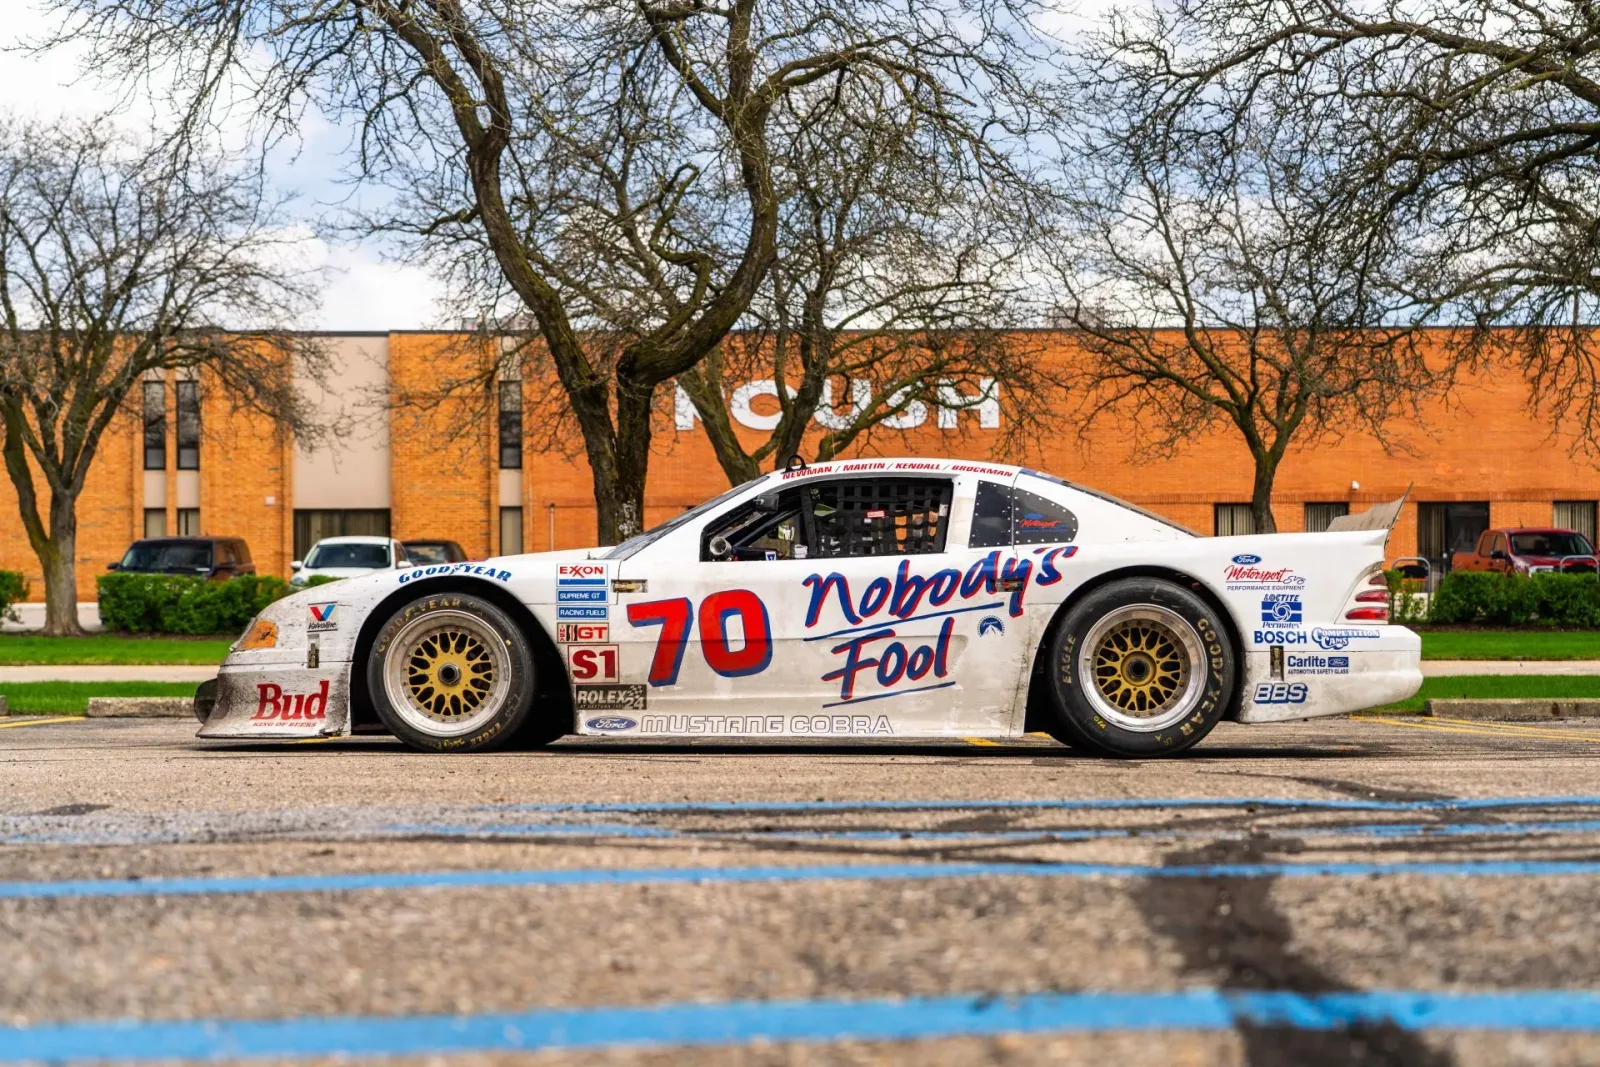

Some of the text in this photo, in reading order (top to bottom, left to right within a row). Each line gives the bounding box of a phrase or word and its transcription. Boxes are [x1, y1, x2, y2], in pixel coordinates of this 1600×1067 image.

[782, 465, 832, 480] NEWMAN
[843, 462, 886, 472] MARTIN
[895, 462, 941, 471] KENDALL
[951, 464, 1013, 477] BROCKMAN
[398, 563, 512, 584] GOODYEAR
[559, 565, 604, 578] EXXON
[1223, 564, 1294, 584] Motorsport
[559, 592, 601, 600] SUPREME GT
[1263, 593, 1300, 602] LOCTITE
[307, 621, 337, 630] Valvoline
[577, 626, 608, 639] GT
[1262, 621, 1300, 629] Permatex
[626, 589, 773, 688] 70
[1253, 630, 1307, 644] BOSCH
[572, 649, 616, 680] S1
[820, 616, 955, 701] Fool
[1060, 634, 1077, 684] EAGLE
[1287, 655, 1326, 668] Carlite
[249, 680, 330, 721] Bud
[577, 690, 645, 710] ROLEX 24
[1253, 682, 1309, 704] BBS
[641, 715, 895, 734] MUSTANG COBRA
